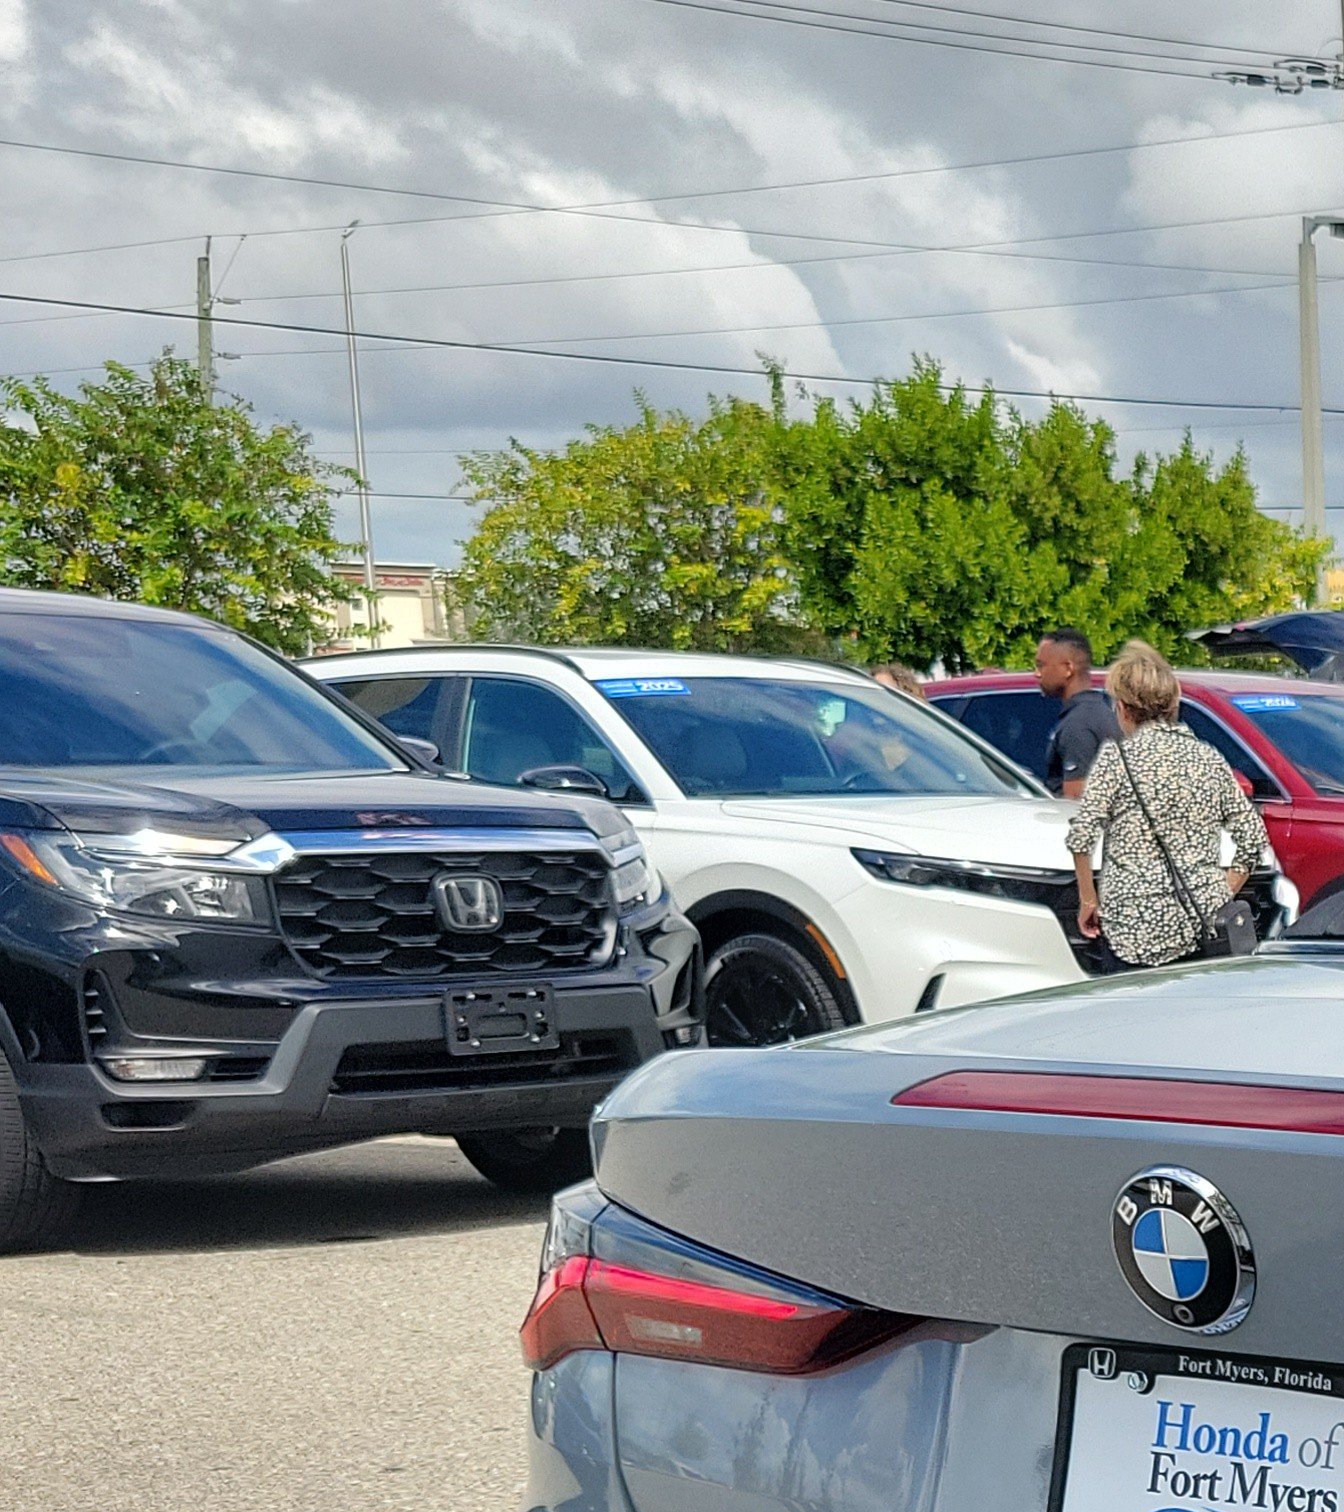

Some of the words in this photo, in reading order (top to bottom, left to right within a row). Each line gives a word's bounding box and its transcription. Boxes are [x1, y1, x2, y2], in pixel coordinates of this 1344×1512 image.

[1116, 1178, 1221, 1234] BMW
[1178, 1355, 1212, 1375] Fort
[1215, 1358, 1269, 1385] Myers,
[1273, 1366, 1333, 1391] Florida
[1151, 1400, 1290, 1464] Honda
[1147, 1450, 1223, 1502] Fort
